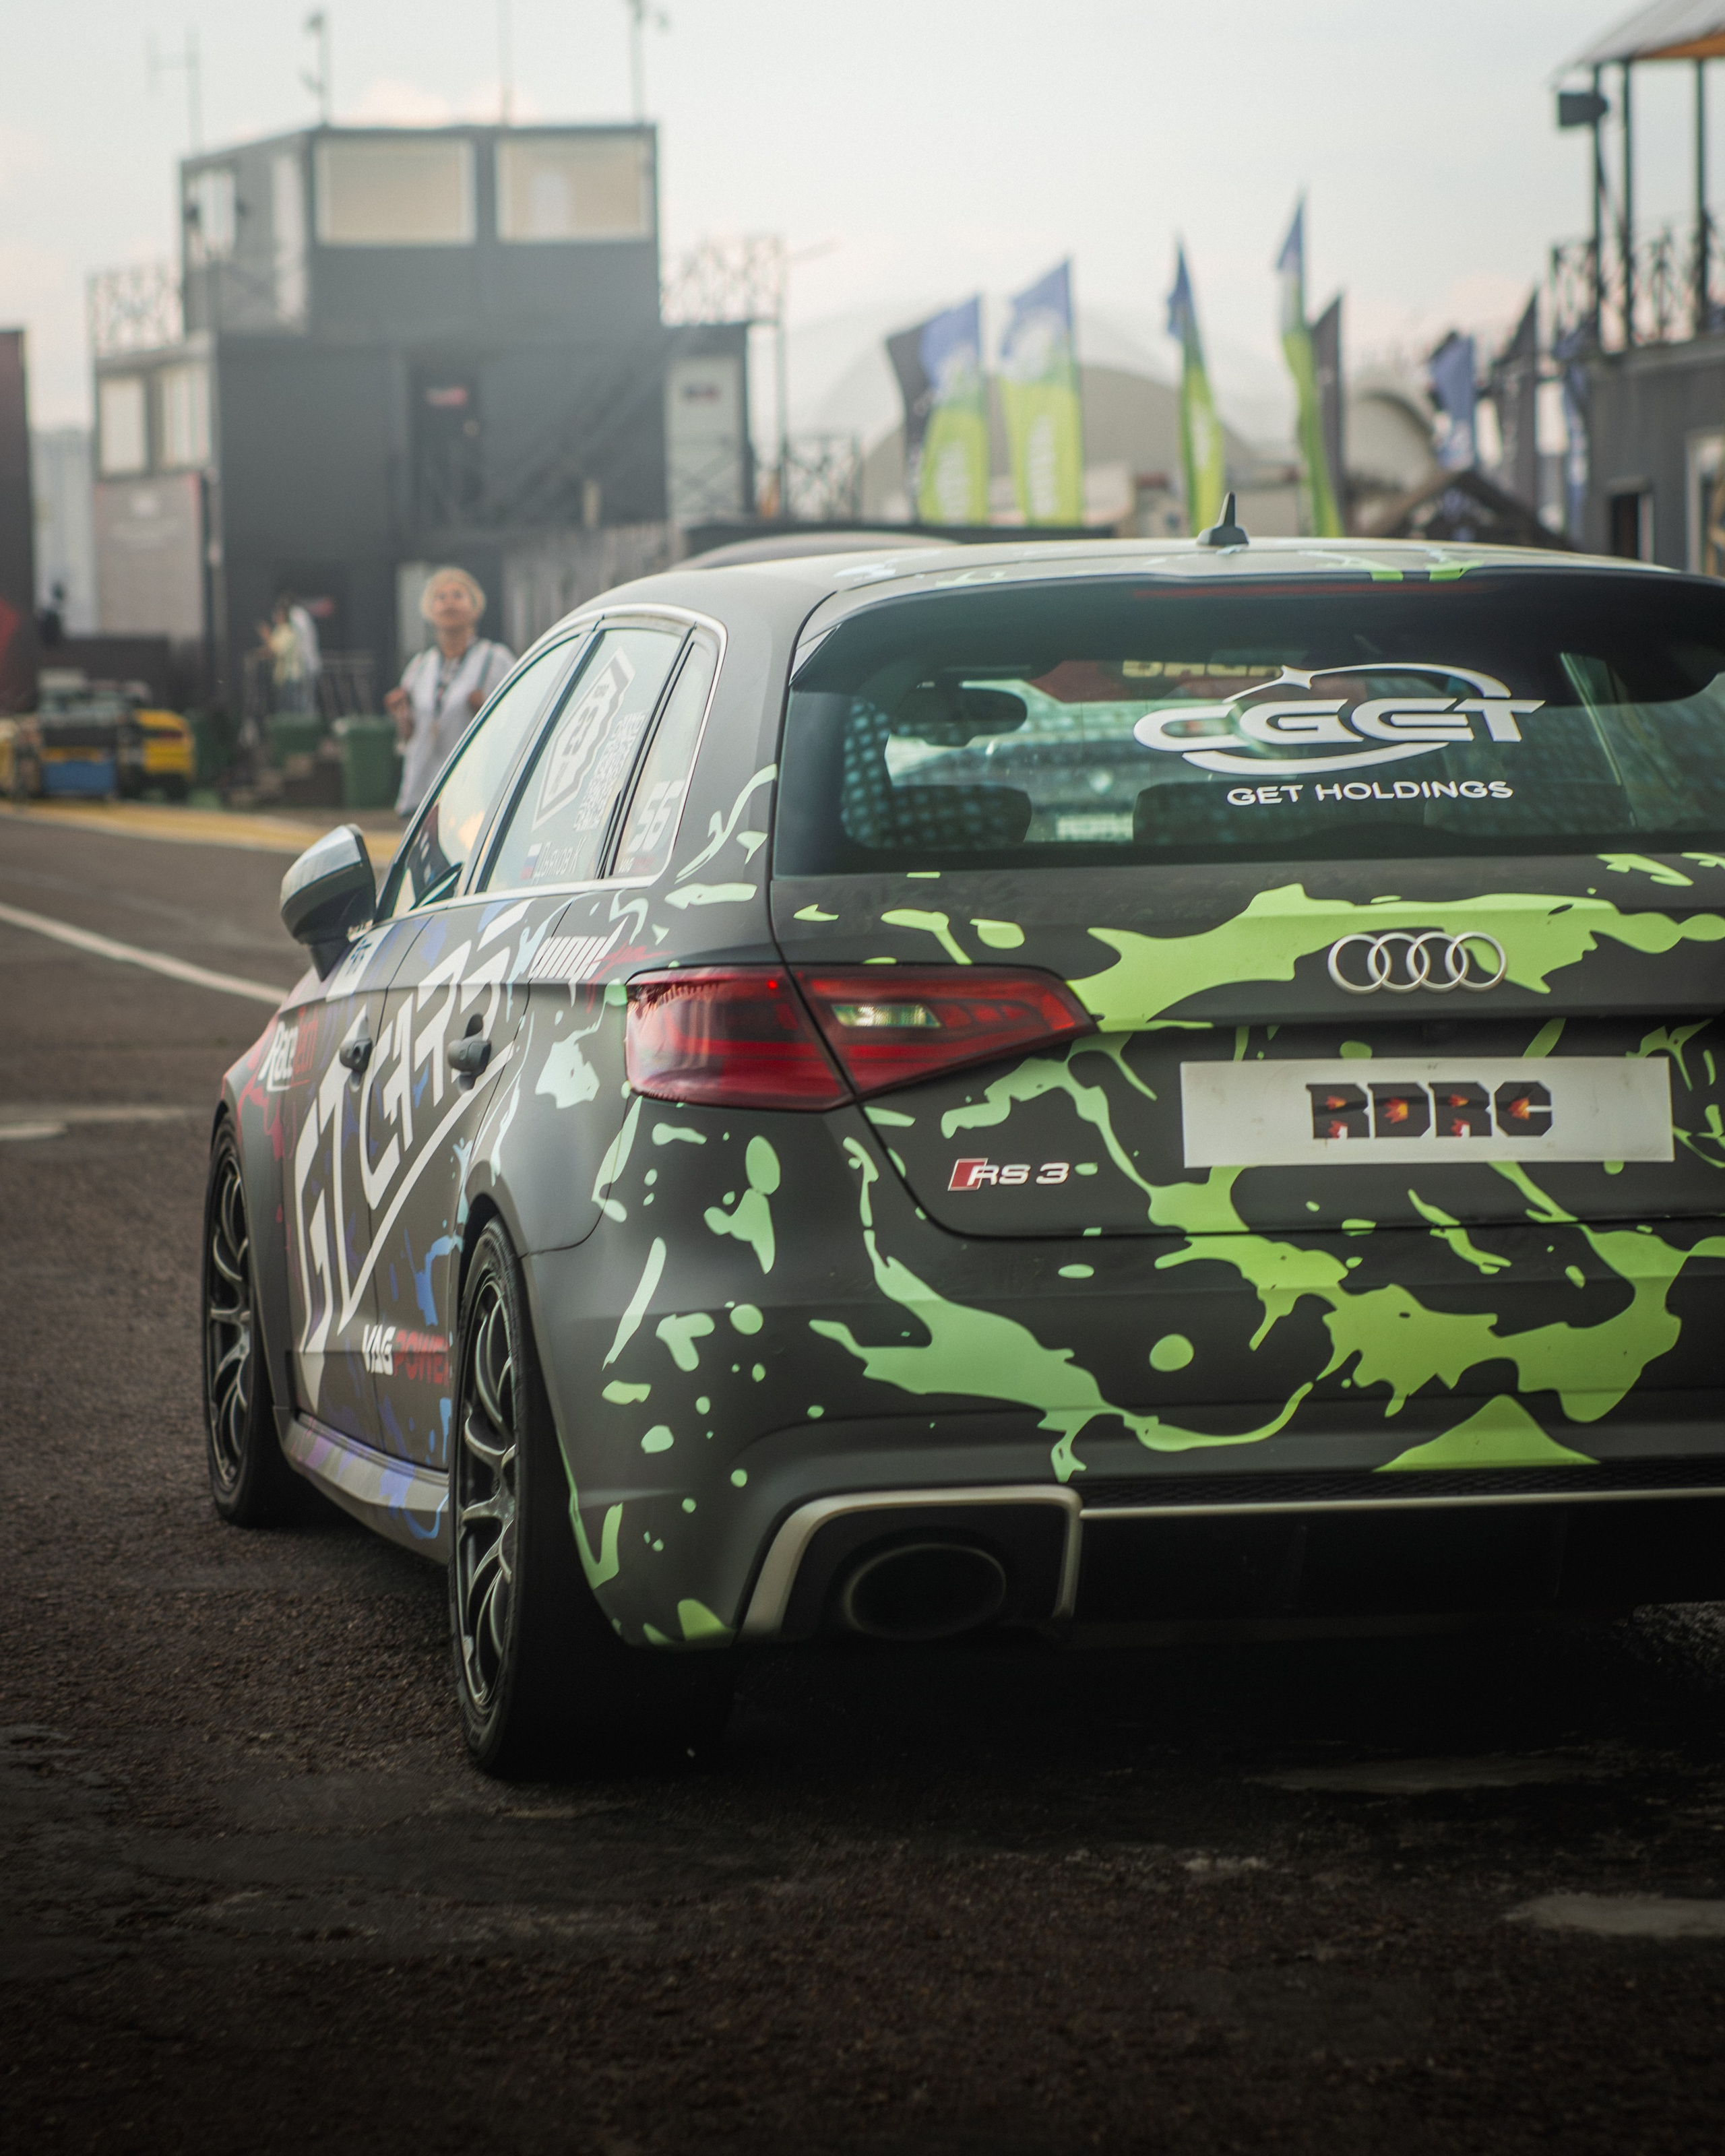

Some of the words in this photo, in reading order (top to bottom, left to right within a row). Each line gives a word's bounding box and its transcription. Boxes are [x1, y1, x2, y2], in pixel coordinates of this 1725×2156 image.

[1226, 784, 1303, 806] GET
[1315, 780, 1513, 802] HOLDINGS
[626, 779, 686, 853] 56
[1305, 1081, 1553, 1140] RDRC
[966, 1164, 1032, 1186] RS
[1036, 1162, 1070, 1184] 3
